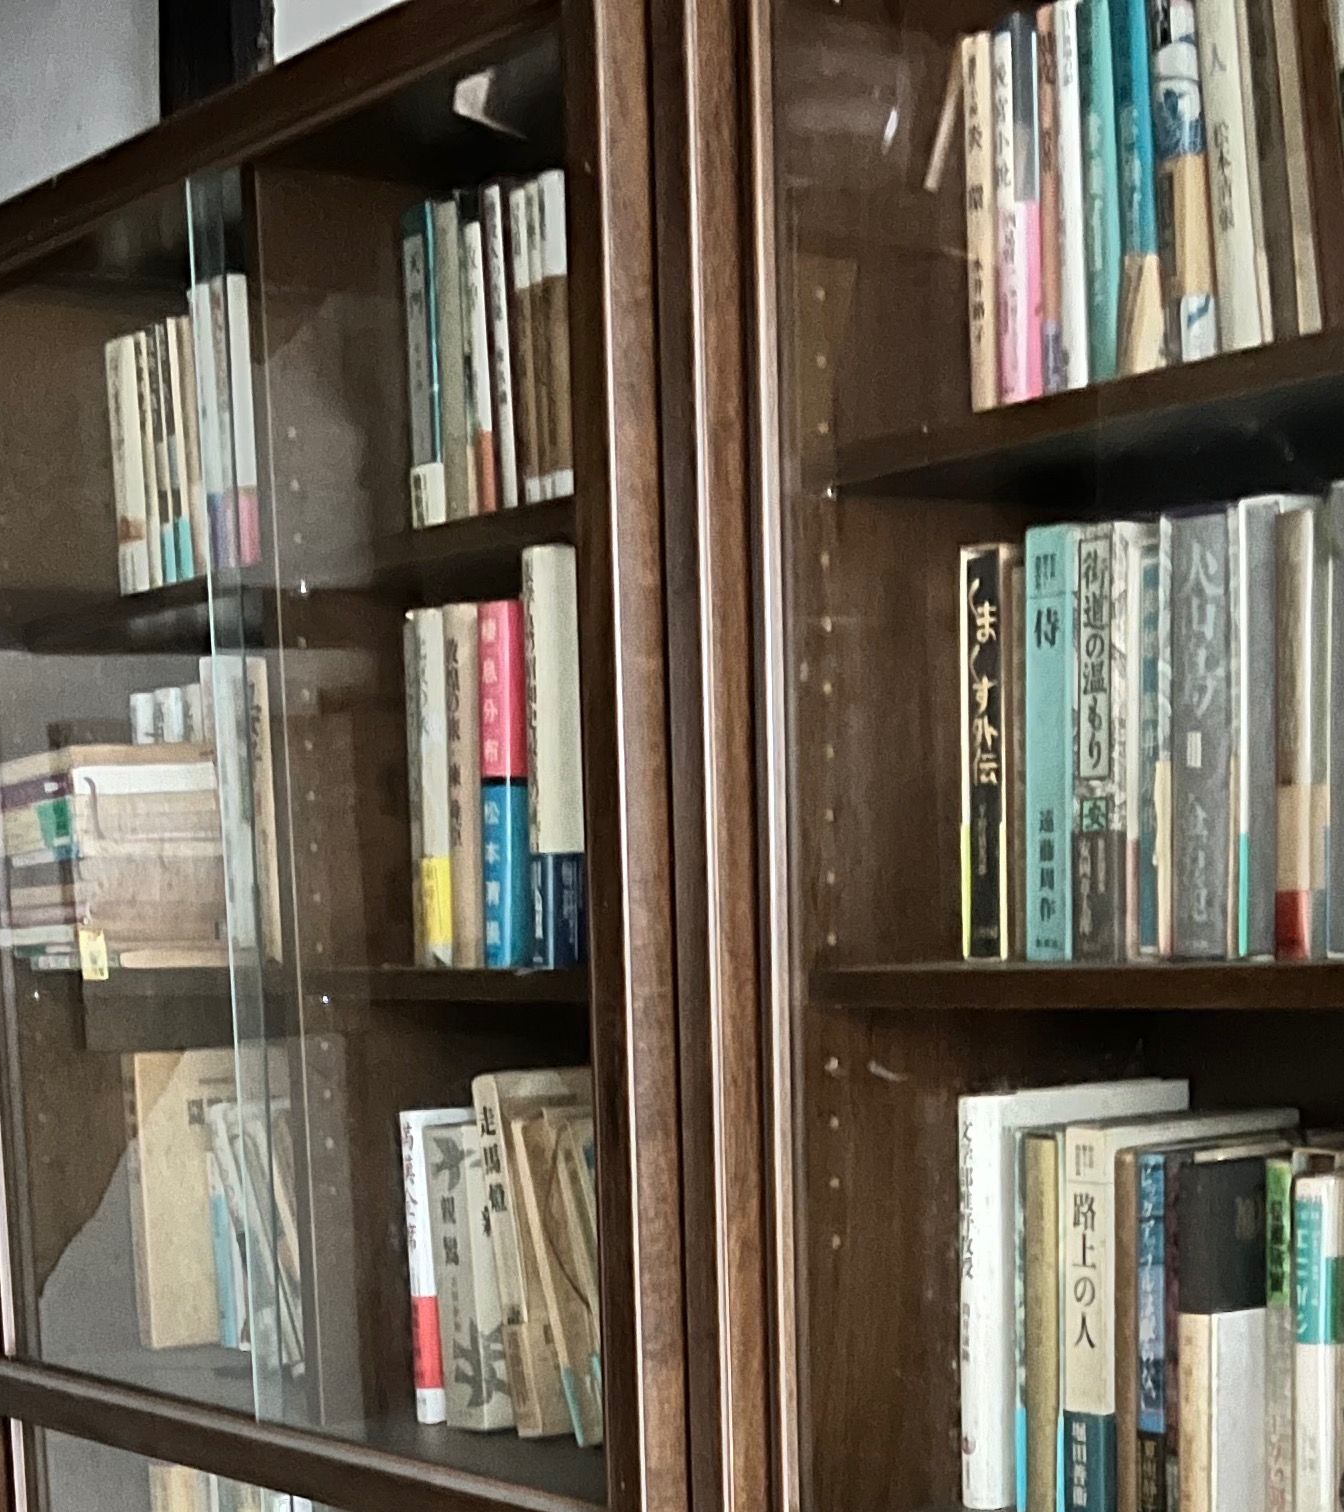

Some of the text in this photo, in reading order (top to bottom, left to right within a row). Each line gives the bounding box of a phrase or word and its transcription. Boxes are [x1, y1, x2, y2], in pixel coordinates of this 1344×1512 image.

[1034, 607, 1060, 649] 侍
[1083, 548, 1109, 770] 街道の温もり
[1072, 1191, 1097, 1350] 路上の人
